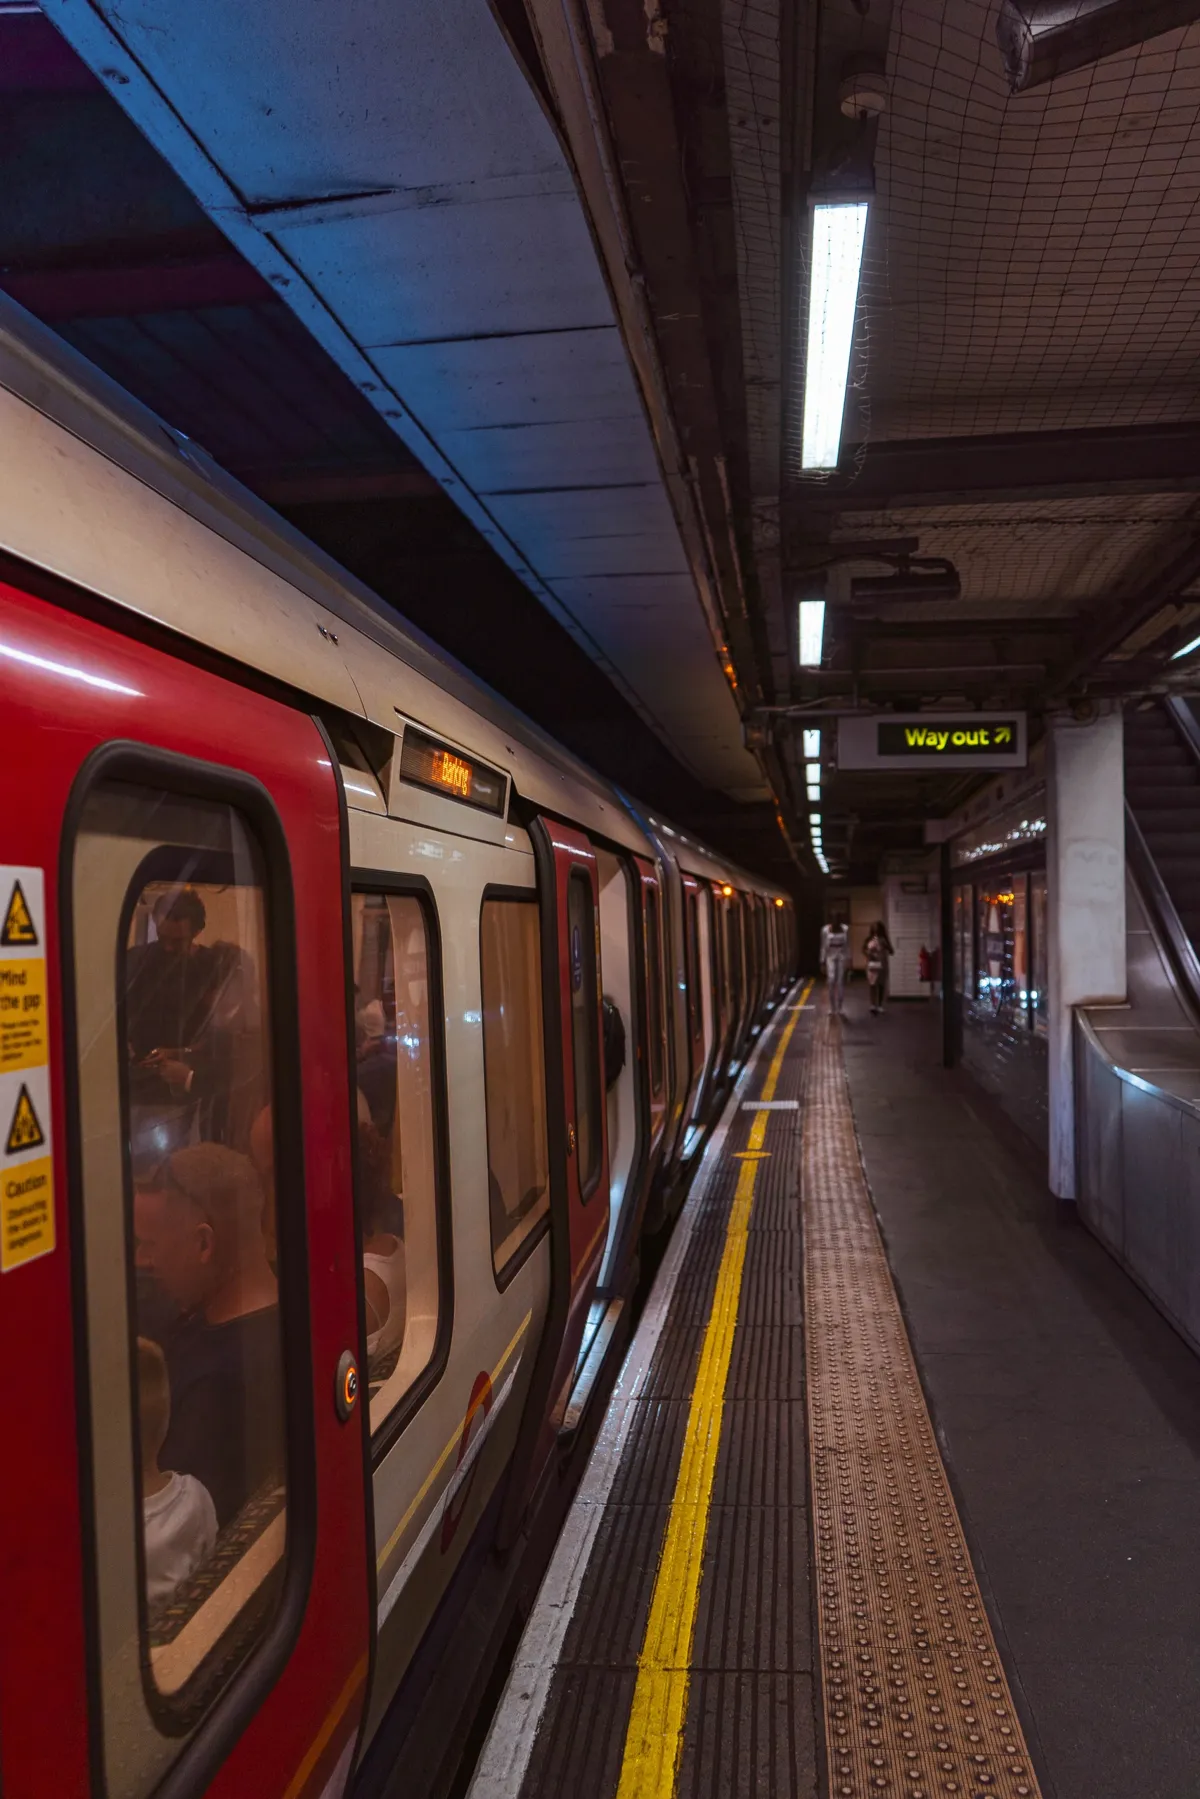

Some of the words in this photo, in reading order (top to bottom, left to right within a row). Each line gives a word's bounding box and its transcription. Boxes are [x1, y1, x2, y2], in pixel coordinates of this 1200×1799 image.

[905, 728, 949, 750] Way
[951, 728, 989, 746] out
[441, 751, 469, 796] Barking
[0, 969, 27, 986] Mind
[22, 993, 41, 1012] gap
[5, 1174, 47, 1198] Caution
